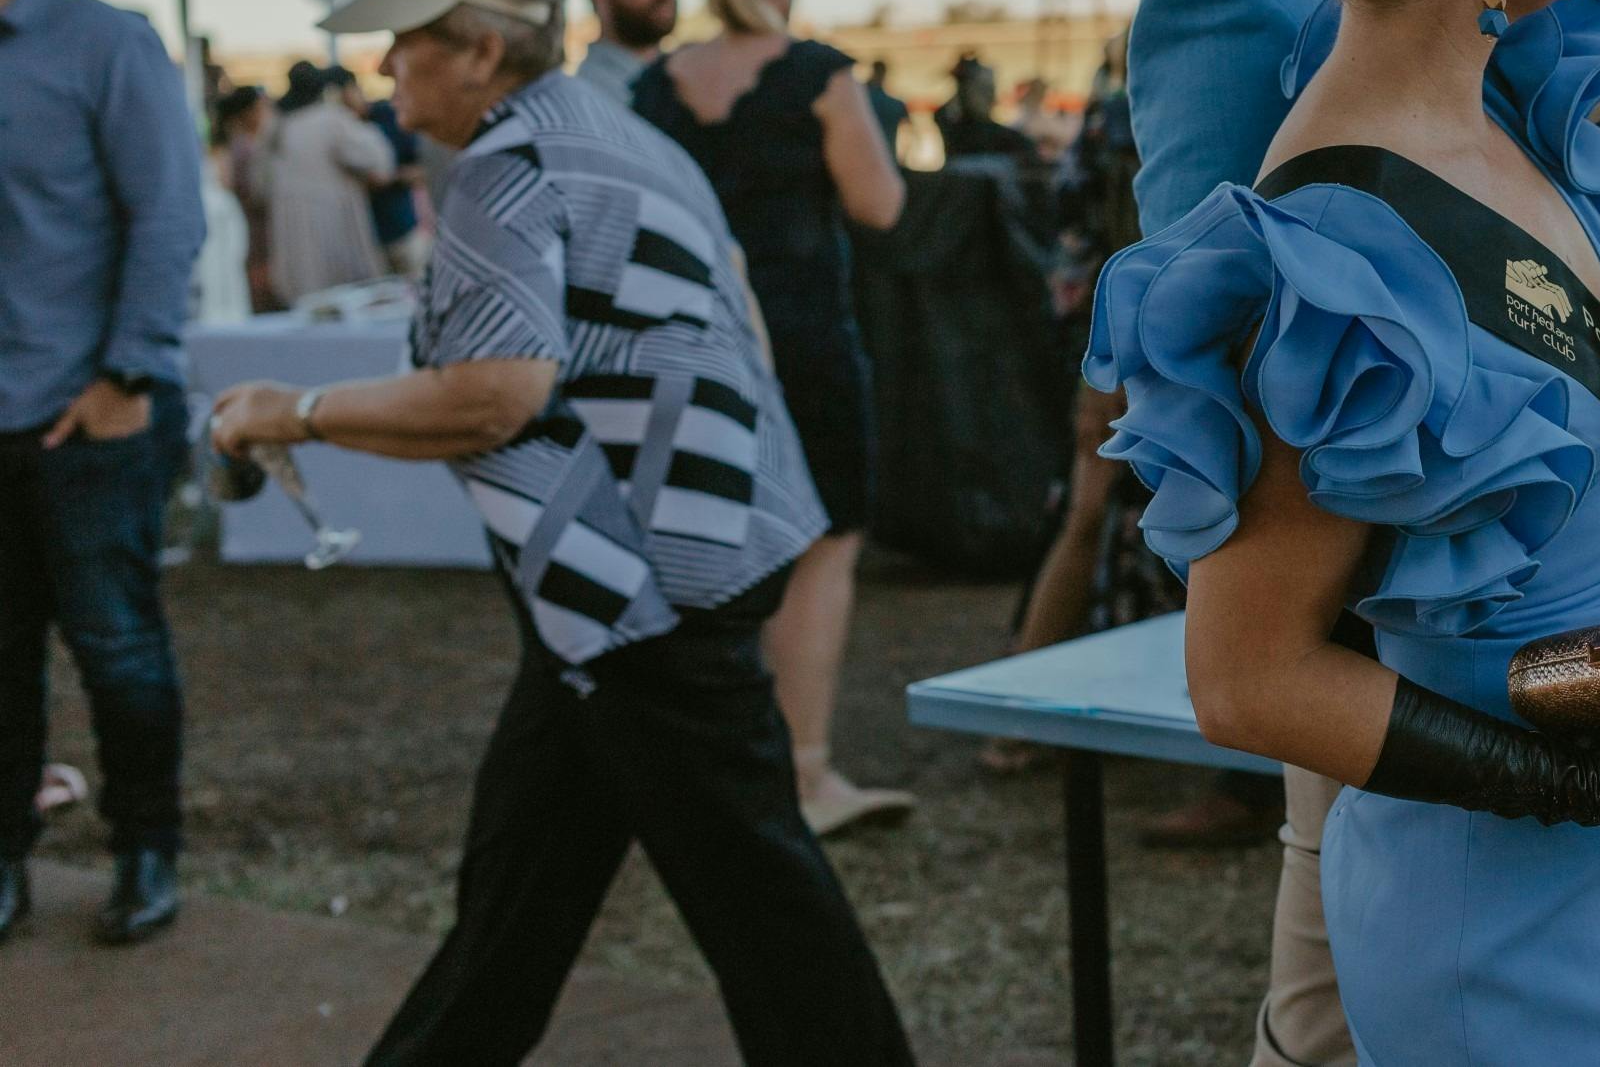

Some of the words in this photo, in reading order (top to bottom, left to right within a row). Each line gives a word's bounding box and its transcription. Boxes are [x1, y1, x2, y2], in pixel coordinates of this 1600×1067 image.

[1506, 294, 1531, 317] port
[1532, 308, 1575, 347] hedland
[1507, 307, 1538, 336] turf
[1542, 333, 1577, 362] club
